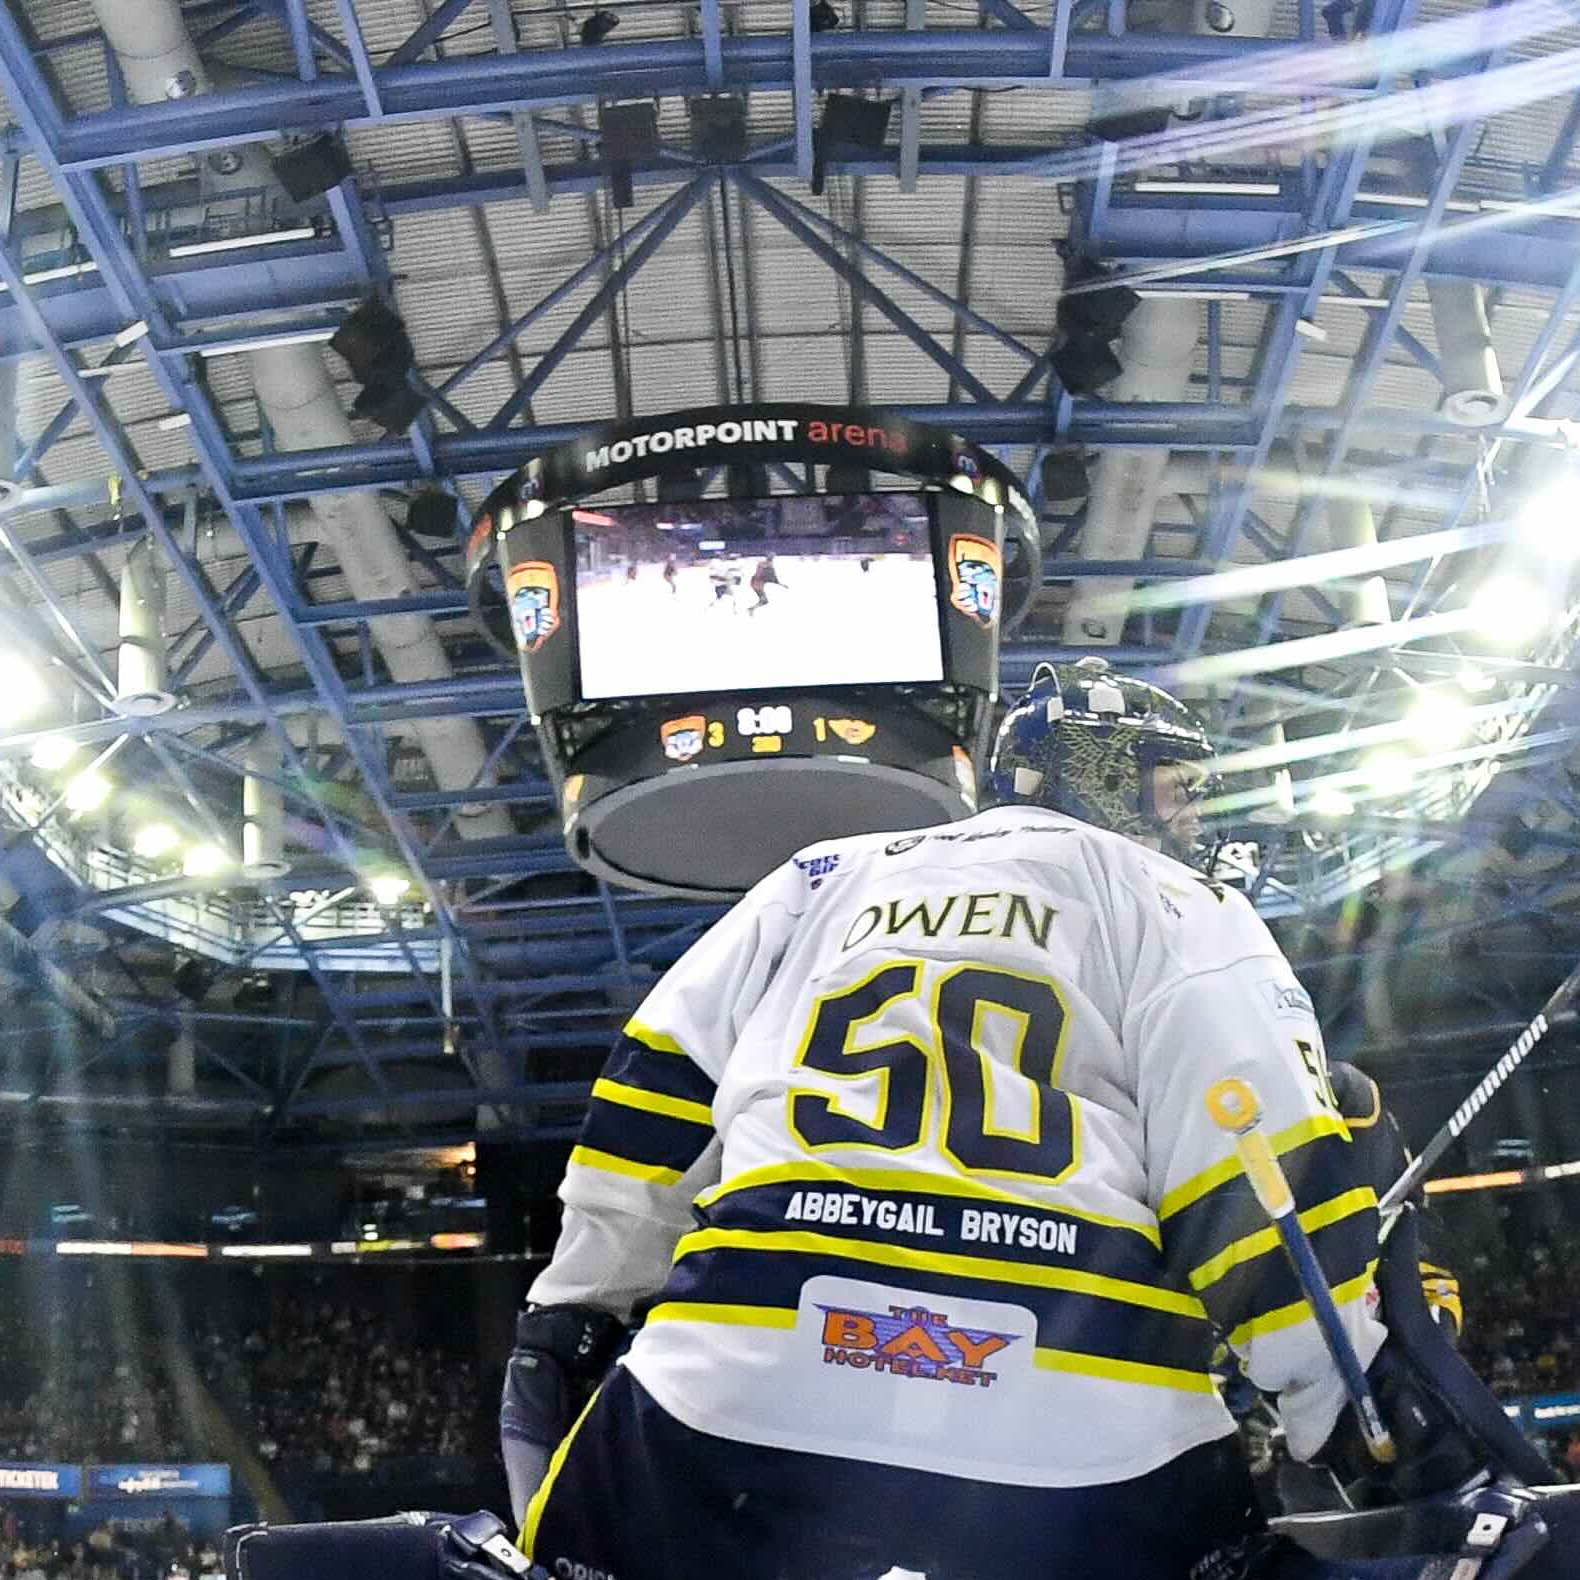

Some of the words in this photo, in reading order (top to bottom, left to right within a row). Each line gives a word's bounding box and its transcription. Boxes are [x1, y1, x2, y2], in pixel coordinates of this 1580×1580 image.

[585, 419, 799, 473] MOTORPOINT
[807, 420, 908, 455] arena
[841, 891, 1060, 952] OWEN
[788, 959, 1083, 1185] 50
[784, 1191, 945, 1236] ABBEYGAIL
[960, 1209, 1077, 1255] BRYSON
[822, 1310, 1012, 1369] BAY
